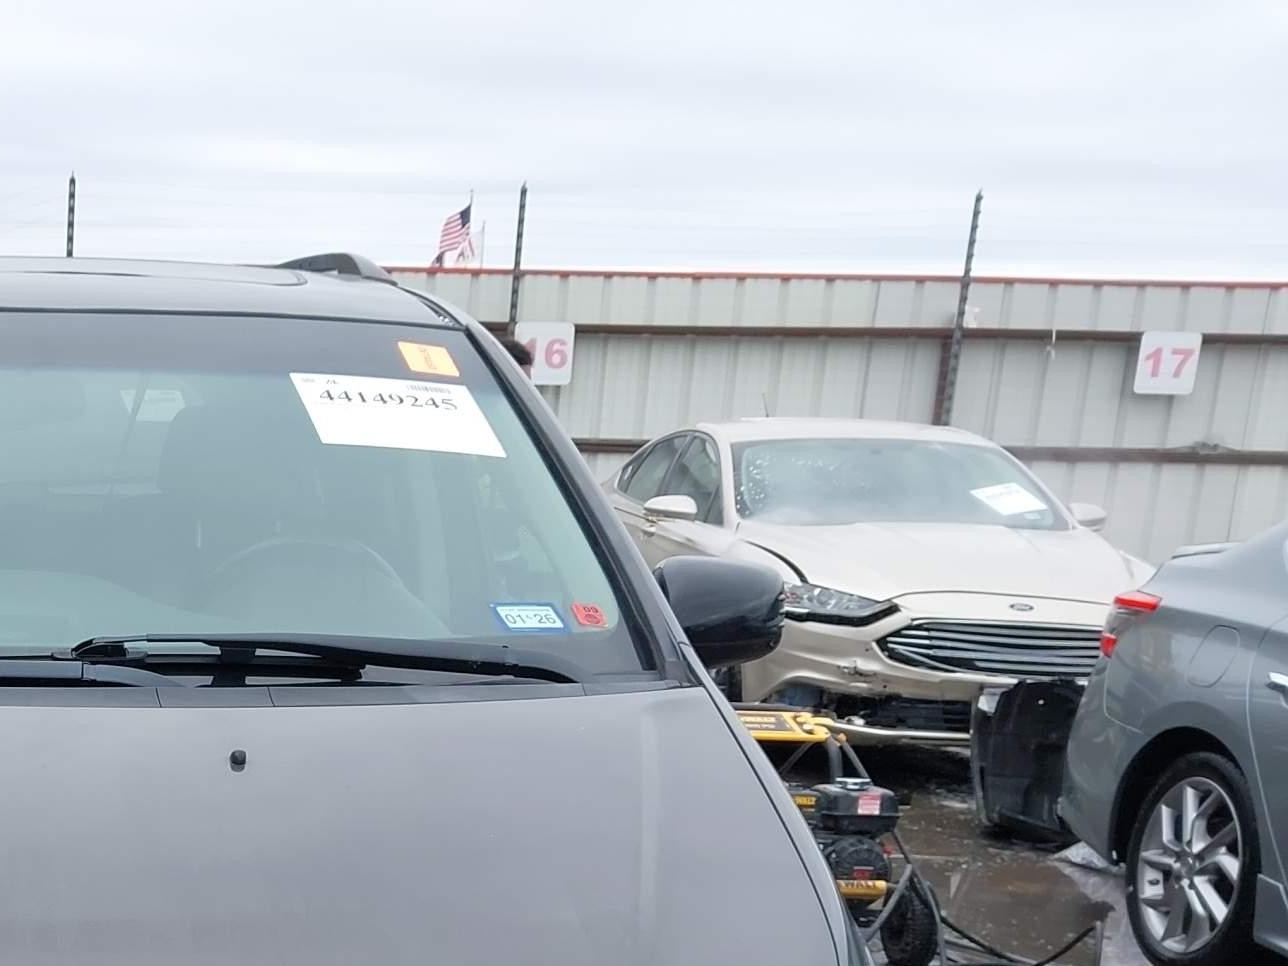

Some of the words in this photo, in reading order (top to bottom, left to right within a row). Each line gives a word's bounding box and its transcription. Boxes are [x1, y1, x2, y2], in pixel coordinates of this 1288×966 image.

[1145, 346, 1195, 378] 17
[319, 389, 458, 411] 44149245
[534, 613, 557, 625] 26
